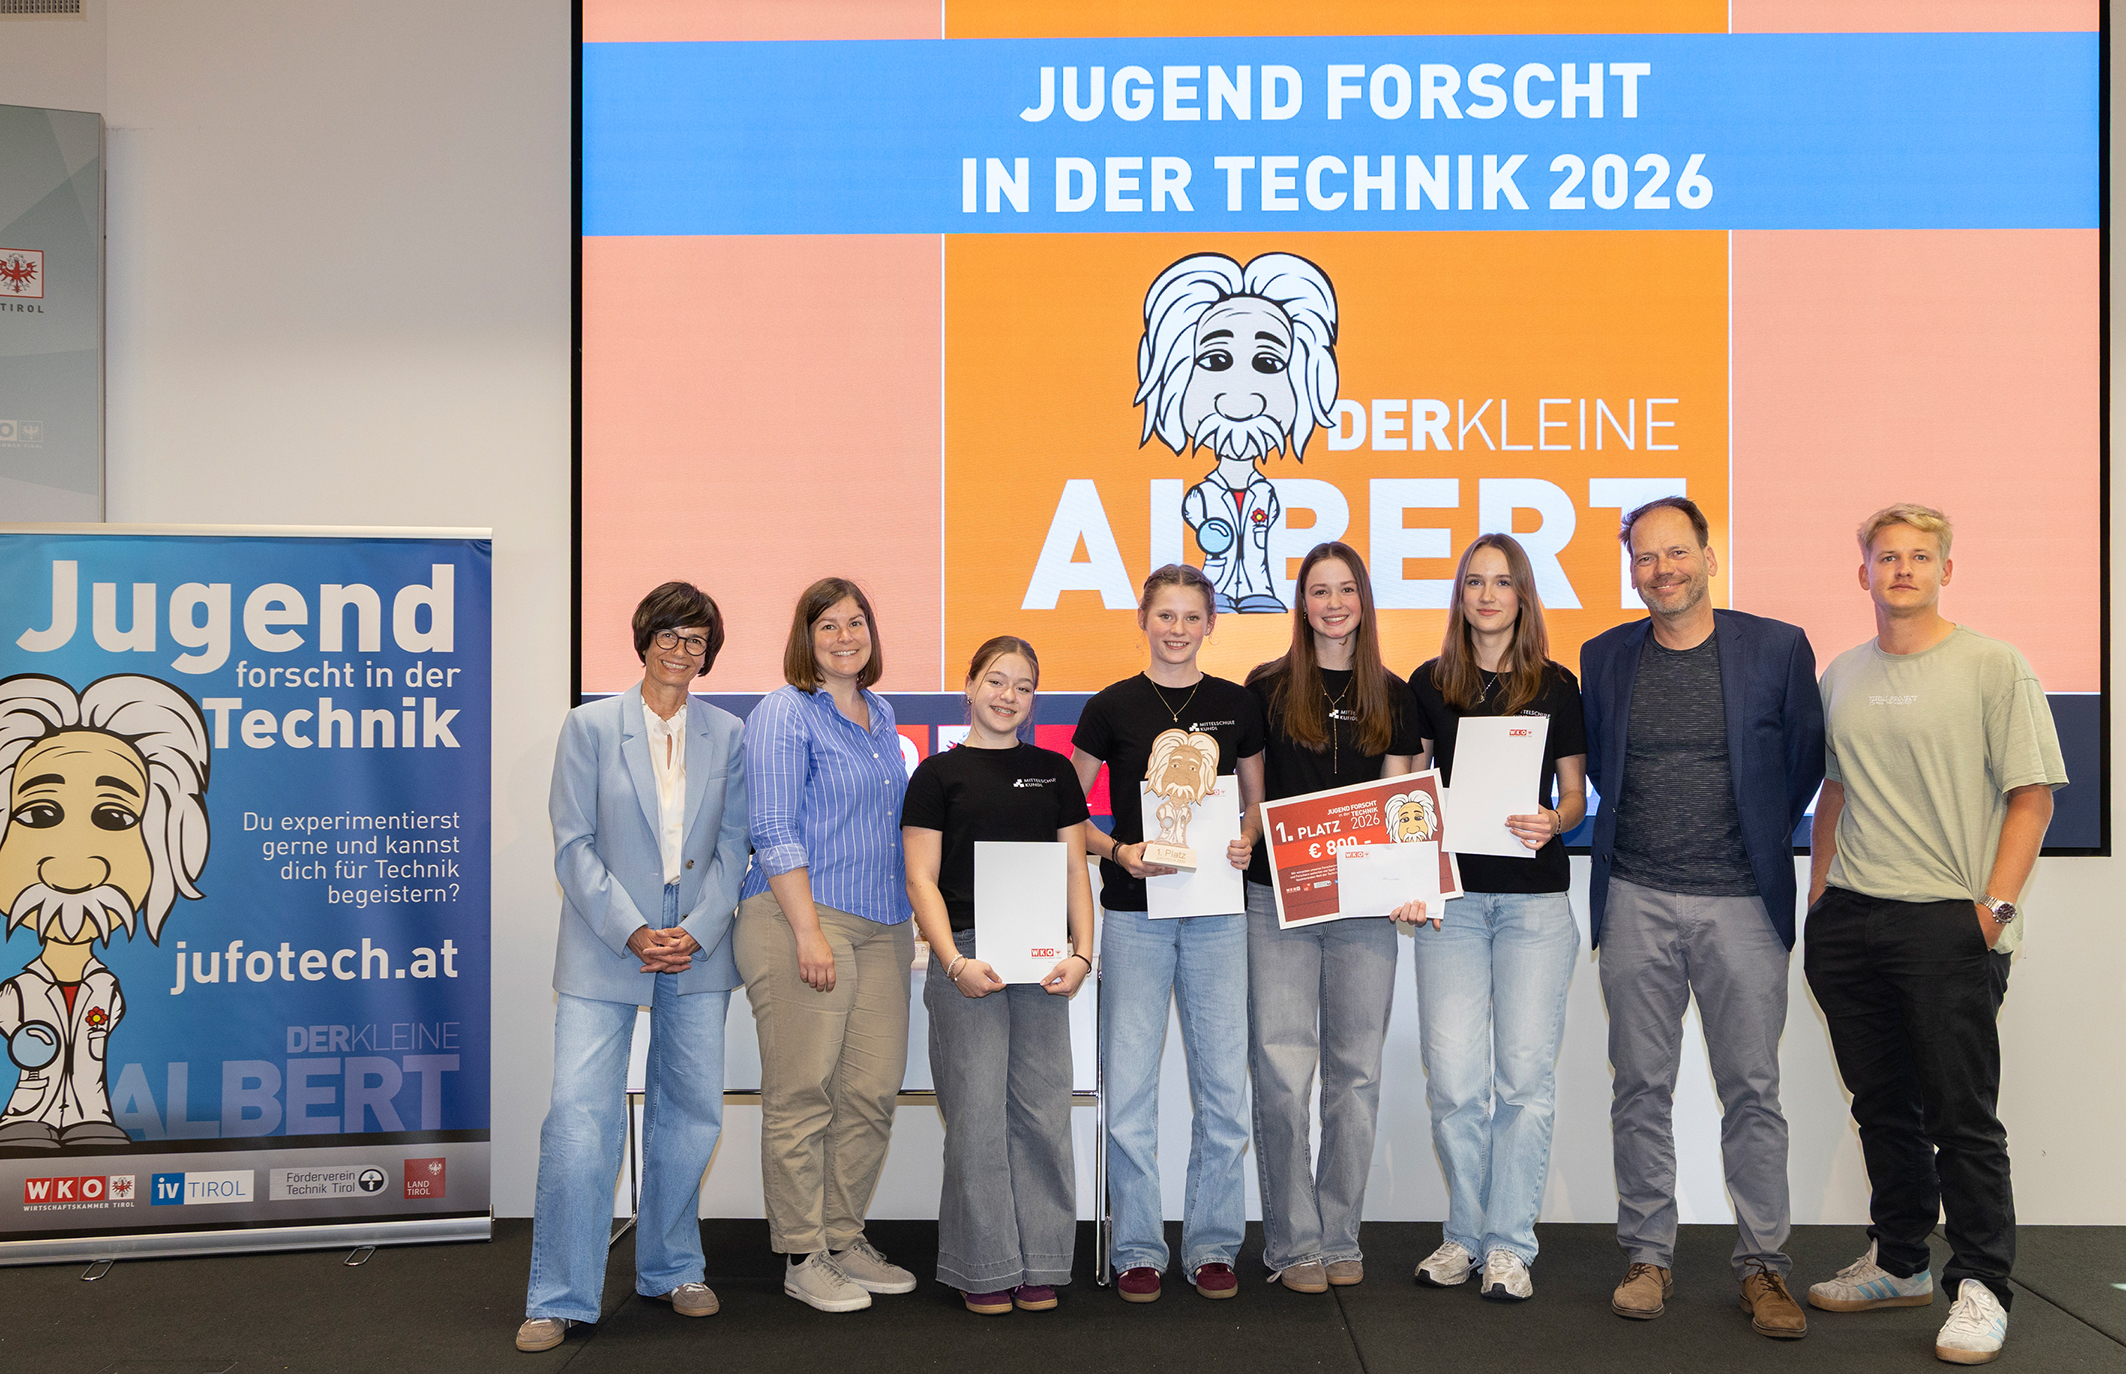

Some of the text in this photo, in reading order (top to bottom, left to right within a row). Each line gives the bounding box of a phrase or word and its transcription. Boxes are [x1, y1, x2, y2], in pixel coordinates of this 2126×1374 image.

[1019, 62, 1651, 122] JUGEND FORSCHT
[962, 153, 1713, 213] IN DER TECHNIK 2026
[0, 303, 45, 313] TIROL
[16, 560, 454, 674] Jugend
[236, 661, 461, 688] forscht in der
[203, 697, 461, 749] Technik
[1327, 800, 1377, 816] JUGEND FORSCHT
[1351, 807, 1379, 817] TECHNIK
[243, 810, 460, 836] Du experimentierst
[1275, 820, 1342, 843] 1. PLATZ
[1350, 813, 1380, 829] 2026
[262, 835, 460, 861] gerne und kannst
[1164, 849, 1187, 860] Platz
[1308, 843, 1323, 859] €
[280, 859, 460, 880] dich für Technik
[328, 883, 460, 908] begeistern?
[1032, 949, 1054, 957] WKO
[170, 938, 459, 995] jufotech.at
[111, 1054, 460, 1142] ALBERT
[286, 1170, 356, 1183] Förderverein
[407, 1180, 430, 1188] LAND
[27, 1179, 103, 1200] WKO
[157, 1177, 246, 1199] iv TIROL
[286, 1182, 356, 1195] Technik Tirol
[407, 1187, 431, 1195] TIROL
[23, 1202, 109, 1212] WIRTSCHAFTSKAMMER
